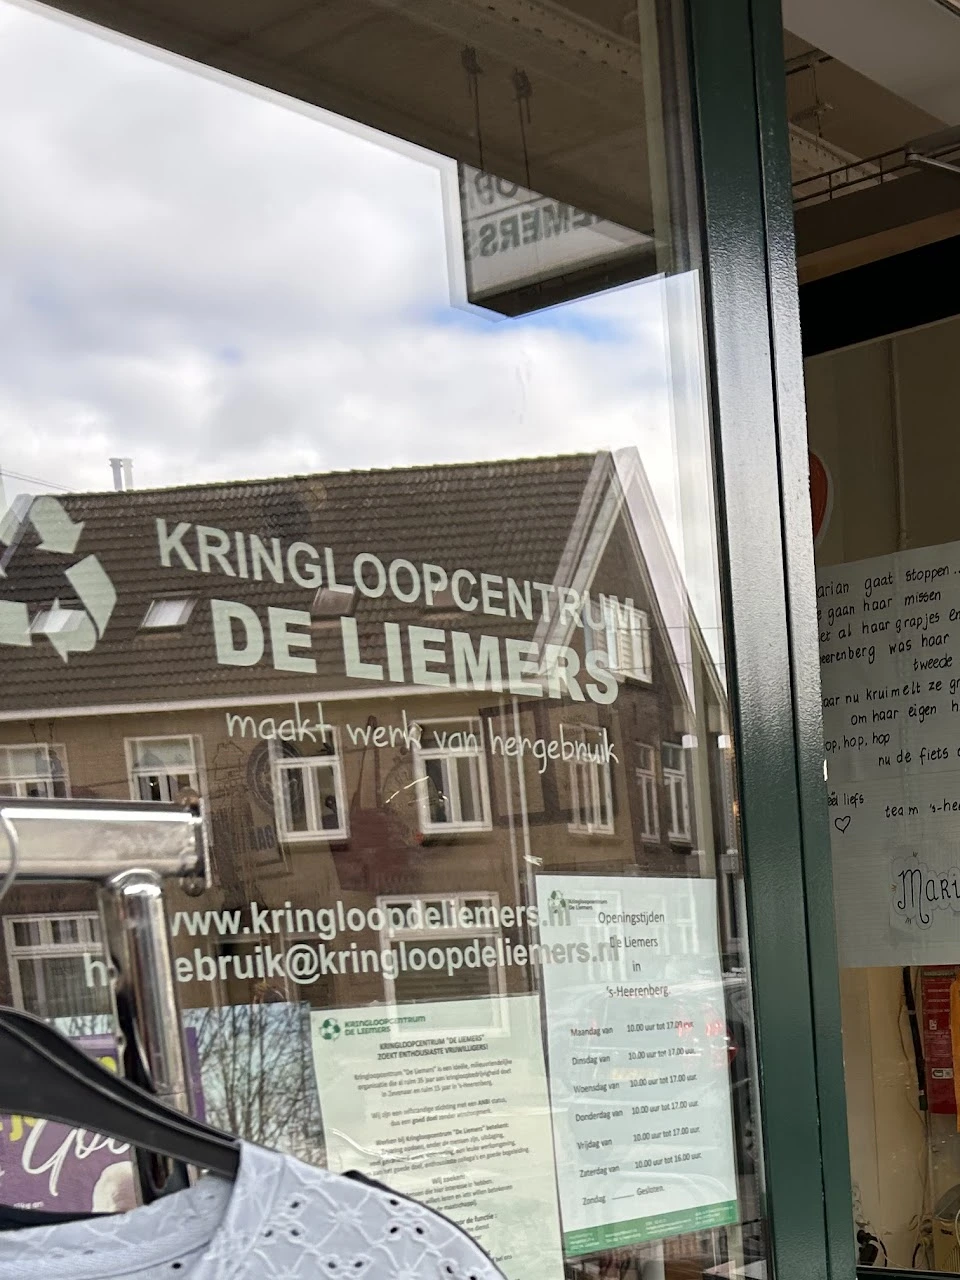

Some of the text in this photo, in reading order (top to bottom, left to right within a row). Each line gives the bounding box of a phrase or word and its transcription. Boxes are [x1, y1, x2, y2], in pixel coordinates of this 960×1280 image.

[155, 518, 636, 634] KRINGLOOPCENTRUM
[816, 581, 850, 599] arian
[864, 573, 893, 598] gaat
[828, 605, 855, 626] gaan
[863, 597, 893, 612] haar
[904, 589, 942, 607] missen
[819, 629, 831, 642] et
[838, 623, 852, 640] al
[862, 620, 891, 635] haar
[895, 611, 940, 632] grapjes
[211, 599, 619, 705] DE LIEMERS
[888, 639, 912, 655] was
[921, 633, 950, 648] haar
[913, 653, 953, 672] tweede
[822, 695, 841, 708] aar
[845, 693, 860, 704] nu
[866, 681, 921, 699] kruimelt
[928, 679, 943, 692] ze
[850, 715, 867, 726] om
[872, 708, 900, 722] haar
[908, 703, 937, 723] eigen
[226, 698, 619, 774] maakt werk van hergebruik
[825, 731, 891, 752] op, hop, hop
[878, 753, 891, 767] nu
[896, 749, 912, 764] de
[919, 747, 949, 766] fiets
[843, 792, 864, 808] liefs
[885, 804, 919, 818] team
[598, 911, 665, 926] Openingstijden
[609, 936, 659, 948] De Liemers
[632, 960, 641, 972] in
[344, 1015, 426, 1028] KRINGLOOPCENTRUM
[344, 1026, 391, 1036] DE LIEMERS
[570, 1027, 601, 1037] Maandag
[602, 1026, 613, 1034] van
[627, 1023, 644, 1033] 10.00
[656, 1022, 665, 1030] tot
[666, 1020, 682, 1029] 17.00
[377, 1051, 398, 1060] ZOEKT
[399, 1047, 444, 1058] ENTHOUSIASTE
[380, 1038, 445, 1050] KRINGLOOPCENTRUM
[572, 1056, 598, 1065] Dinsdag
[599, 1055, 610, 1063] van
[628, 1051, 646, 1060] 10.00
[658, 1049, 667, 1057] tot
[667, 1047, 684, 1056] 17.00
[573, 1083, 607, 1093] Woensdag
[608, 1082, 619, 1090] van
[629, 1078, 647, 1087] 10.00
[659, 1076, 668, 1084] tot
[669, 1074, 686, 1083] 17.00
[575, 1111, 611, 1122] Donderdag
[612, 1109, 623, 1117] van
[631, 1105, 649, 1115] 10.00
[661, 1103, 670, 1111] tot
[671, 1100, 687, 1110] 17.00
[577, 1139, 600, 1150] Vrijdag
[601, 1138, 612, 1146] van
[633, 1132, 650, 1142] 10.00
[662, 1130, 671, 1138] tot
[672, 1127, 689, 1137] 17.00
[579, 1167, 607, 1178] Zaterdag
[608, 1165, 620, 1173] van
[634, 1159, 652, 1169] 10.00
[653, 1158, 663, 1166] uur
[664, 1156, 673, 1165] tot
[674, 1153, 690, 1163] 16.00
[582, 1195, 606, 1206] Zondag
